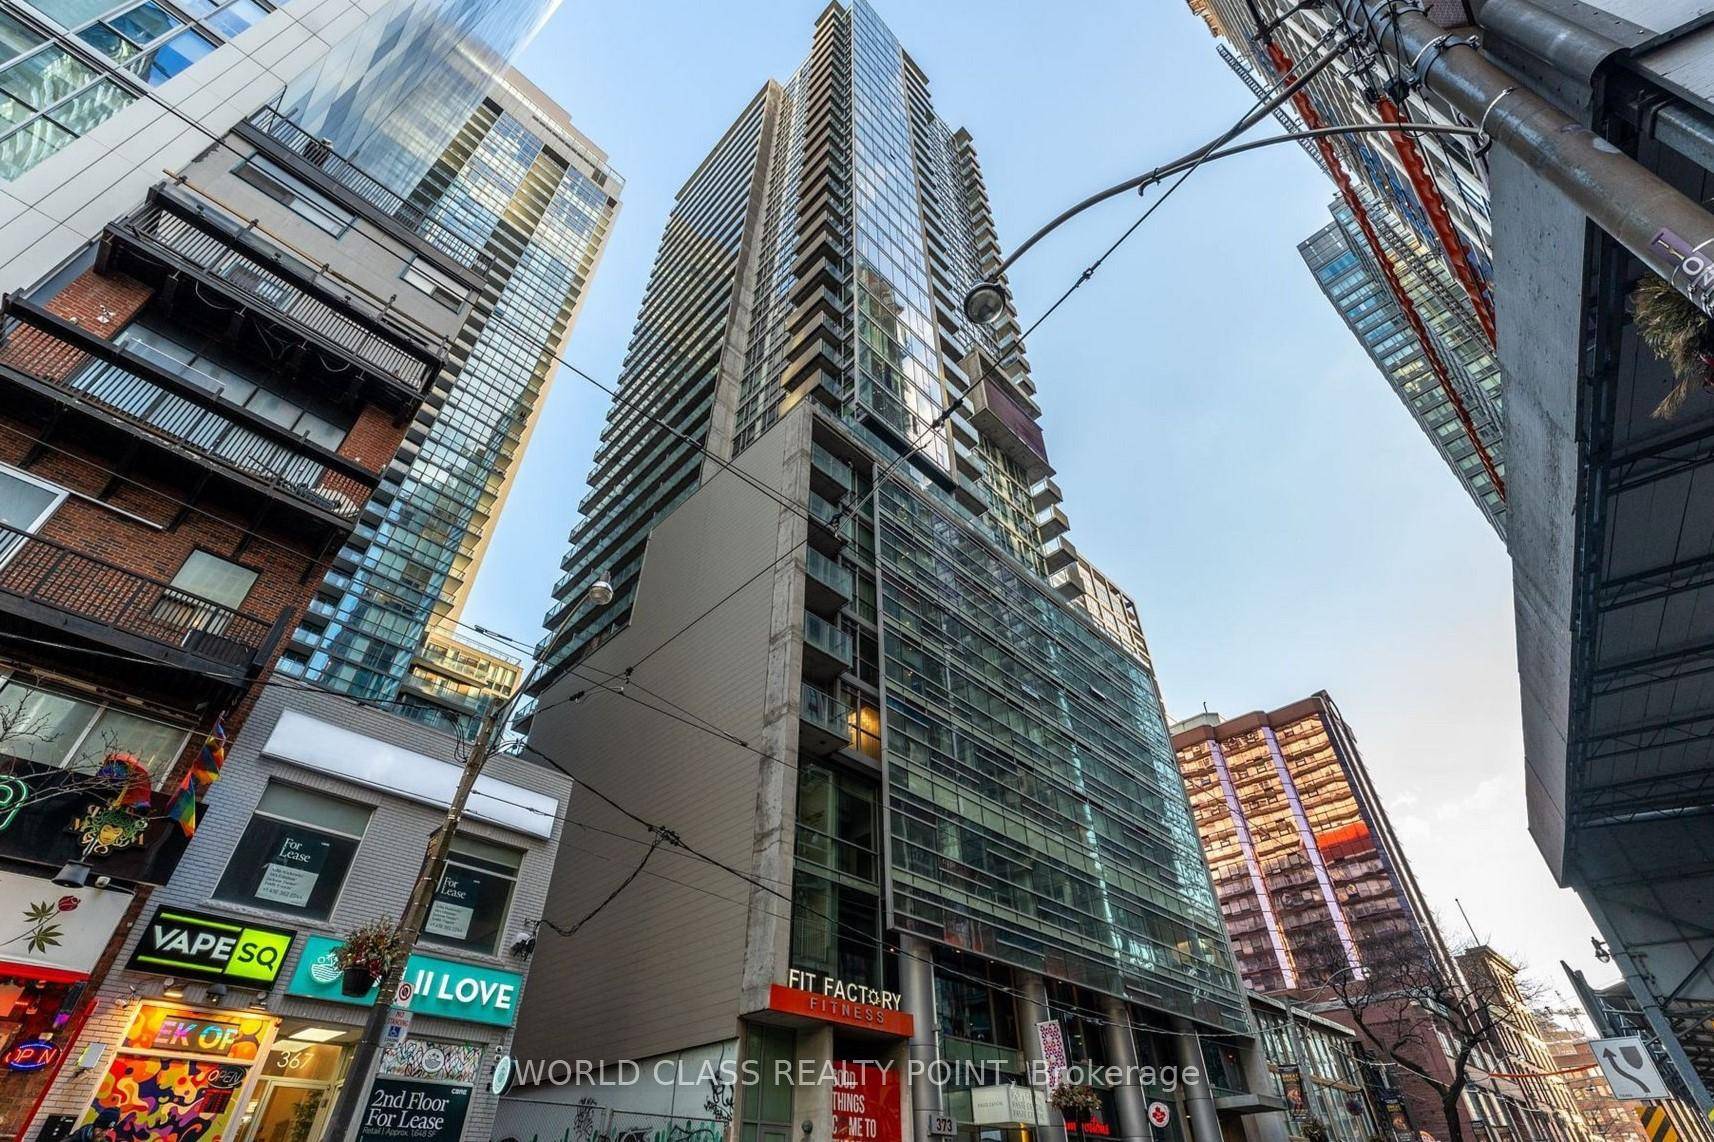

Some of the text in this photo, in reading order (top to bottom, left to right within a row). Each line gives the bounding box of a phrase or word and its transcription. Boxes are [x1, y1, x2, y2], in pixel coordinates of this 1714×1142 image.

[282, 838, 303, 850] For
[279, 847, 311, 863] Lease
[441, 885, 466, 899] Lease
[443, 877, 459, 888] For
[154, 925, 278, 972] VAPE SQ
[437, 974, 513, 1010] LOVE
[789, 968, 902, 1011] FIT FACTORY
[810, 997, 884, 1024] FITNESS
[277, 1050, 314, 1069] 367
[371, 1089, 450, 1112] 2nd Floor
[832, 1091, 865, 1114] THINGS
[365, 1108, 444, 1130] For Lease
[865, 1117, 877, 1138] TO
[936, 1118, 952, 1132] 373
